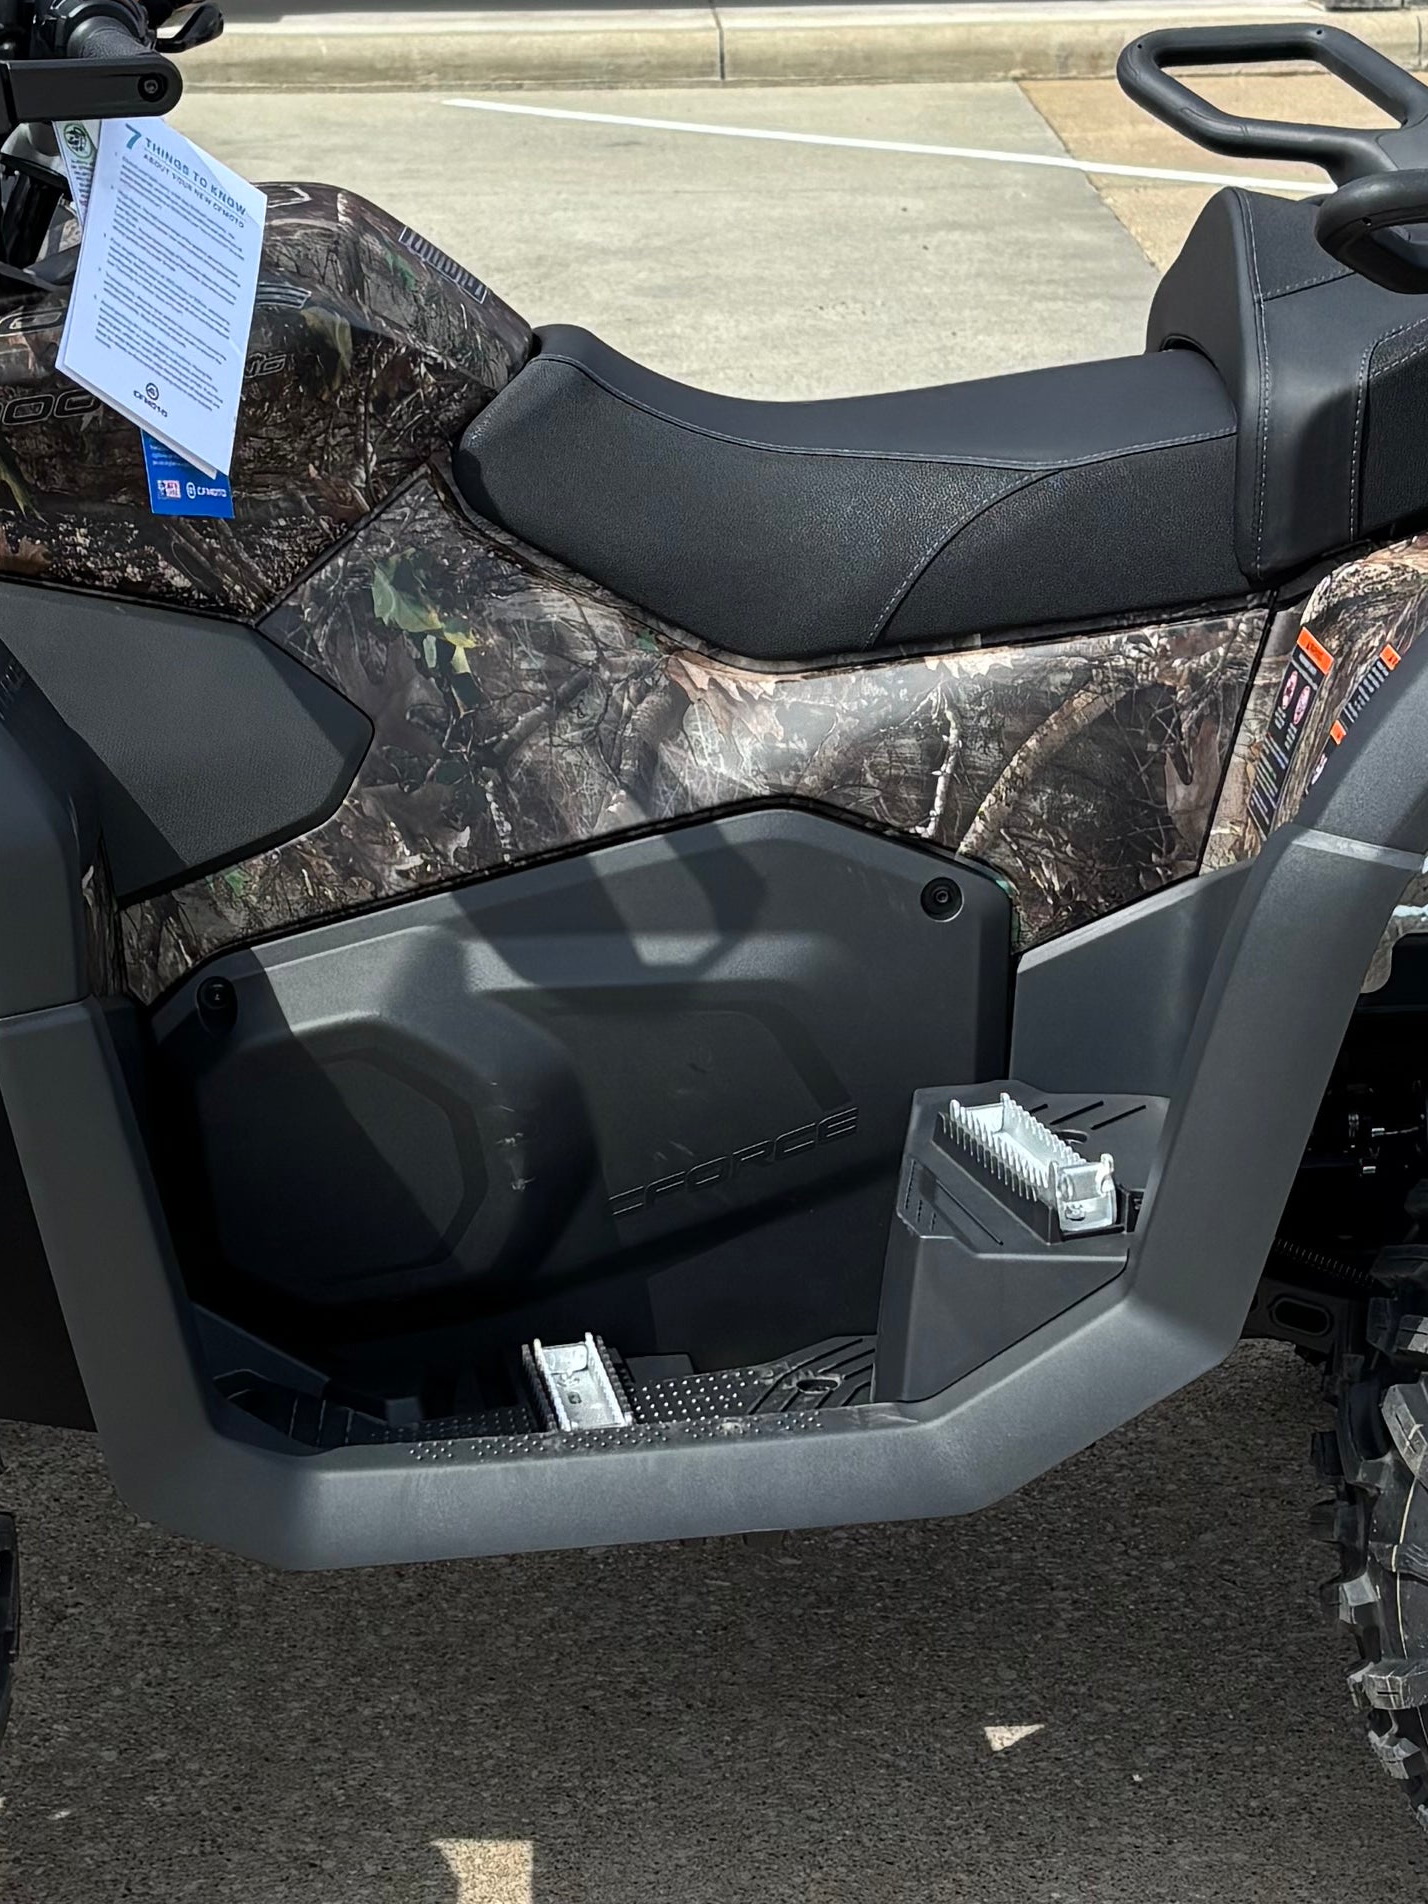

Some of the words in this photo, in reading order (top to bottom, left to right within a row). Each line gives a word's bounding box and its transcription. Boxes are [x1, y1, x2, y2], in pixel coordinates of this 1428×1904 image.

[125, 123, 142, 150] 7
[145, 137, 190, 176] THINGS
[193, 171, 208, 189] TO
[211, 184, 247, 216] KNOW
[143, 154, 170, 176] ABOUT
[194, 188, 212, 206] NEW
